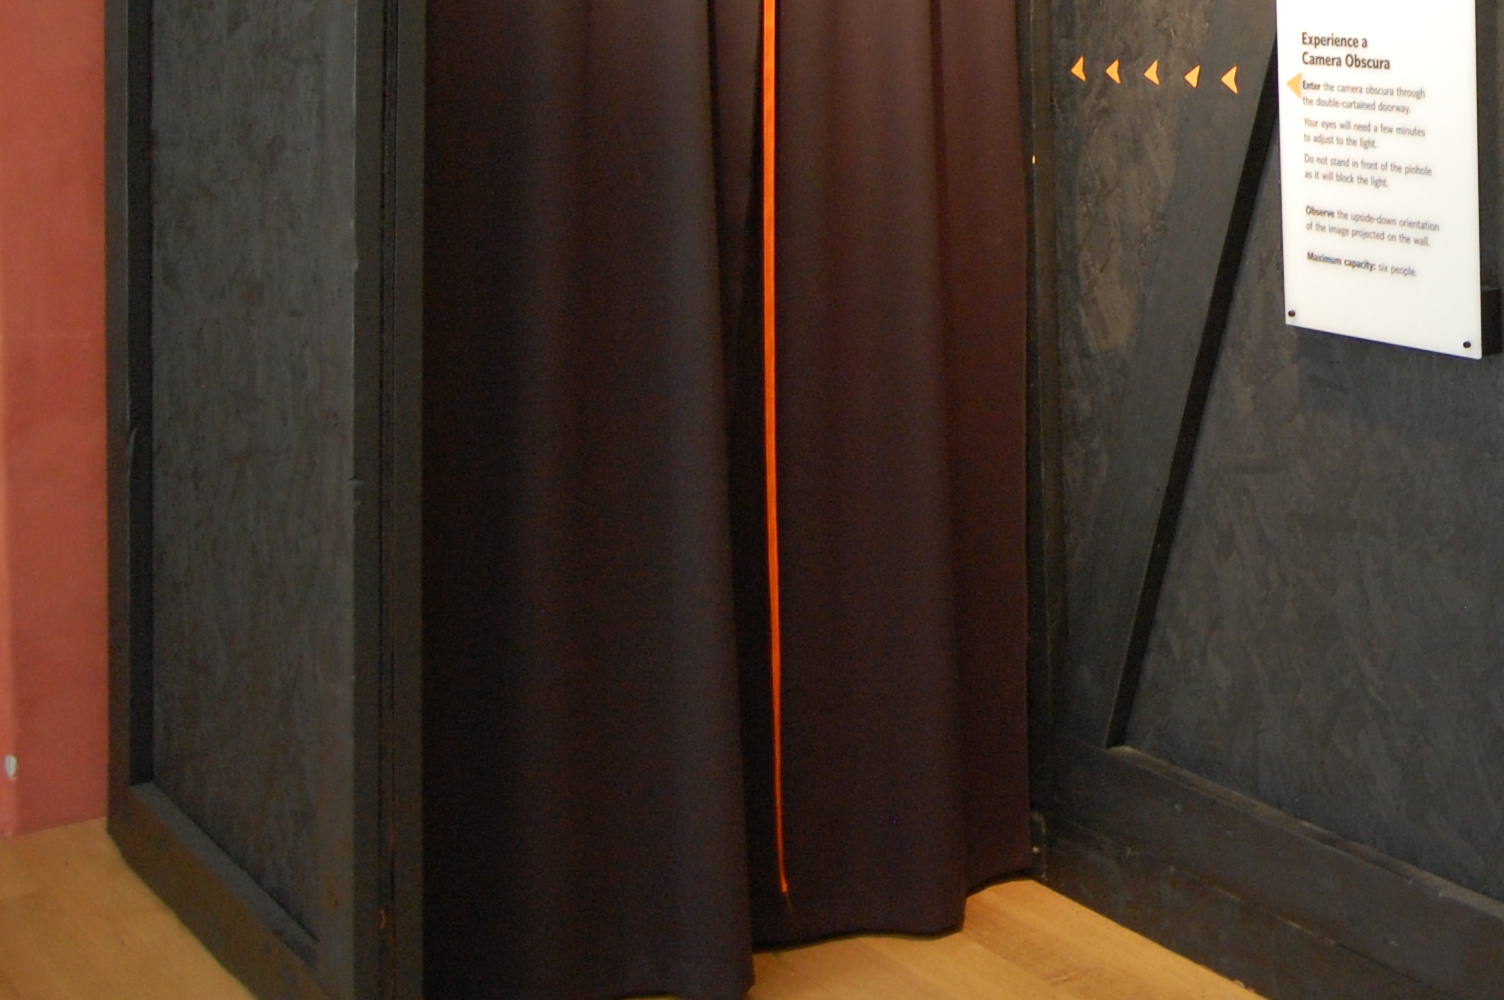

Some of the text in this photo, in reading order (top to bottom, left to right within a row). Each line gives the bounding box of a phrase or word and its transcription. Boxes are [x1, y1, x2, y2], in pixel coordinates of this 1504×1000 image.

[1302, 32, 1368, 48] Experience a
[1302, 51, 1390, 70] Camera Obscura
[1302, 80, 1426, 100] Enter the camera obscura through
[1302, 96, 1411, 115] the double-curtained doorway.
[1304, 117, 1318, 128] Your
[1321, 121, 1337, 130] eyes
[1339, 120, 1351, 130] will
[1354, 122, 1371, 132] need
[1380, 124, 1393, 134] few
[1396, 126, 1426, 136] minutes
[1304, 134, 1377, 150] to adjust to the light.
[1304, 153, 1432, 176] Do not stand in front of the pinhole
[1304, 171, 1388, 188] as it will block the light.
[1306, 205, 1440, 232] Observe the upside-down orientation
[1306, 221, 1430, 246] of the image projected on the wall.
[1306, 251, 1417, 277] Maximum capacity: six people.
